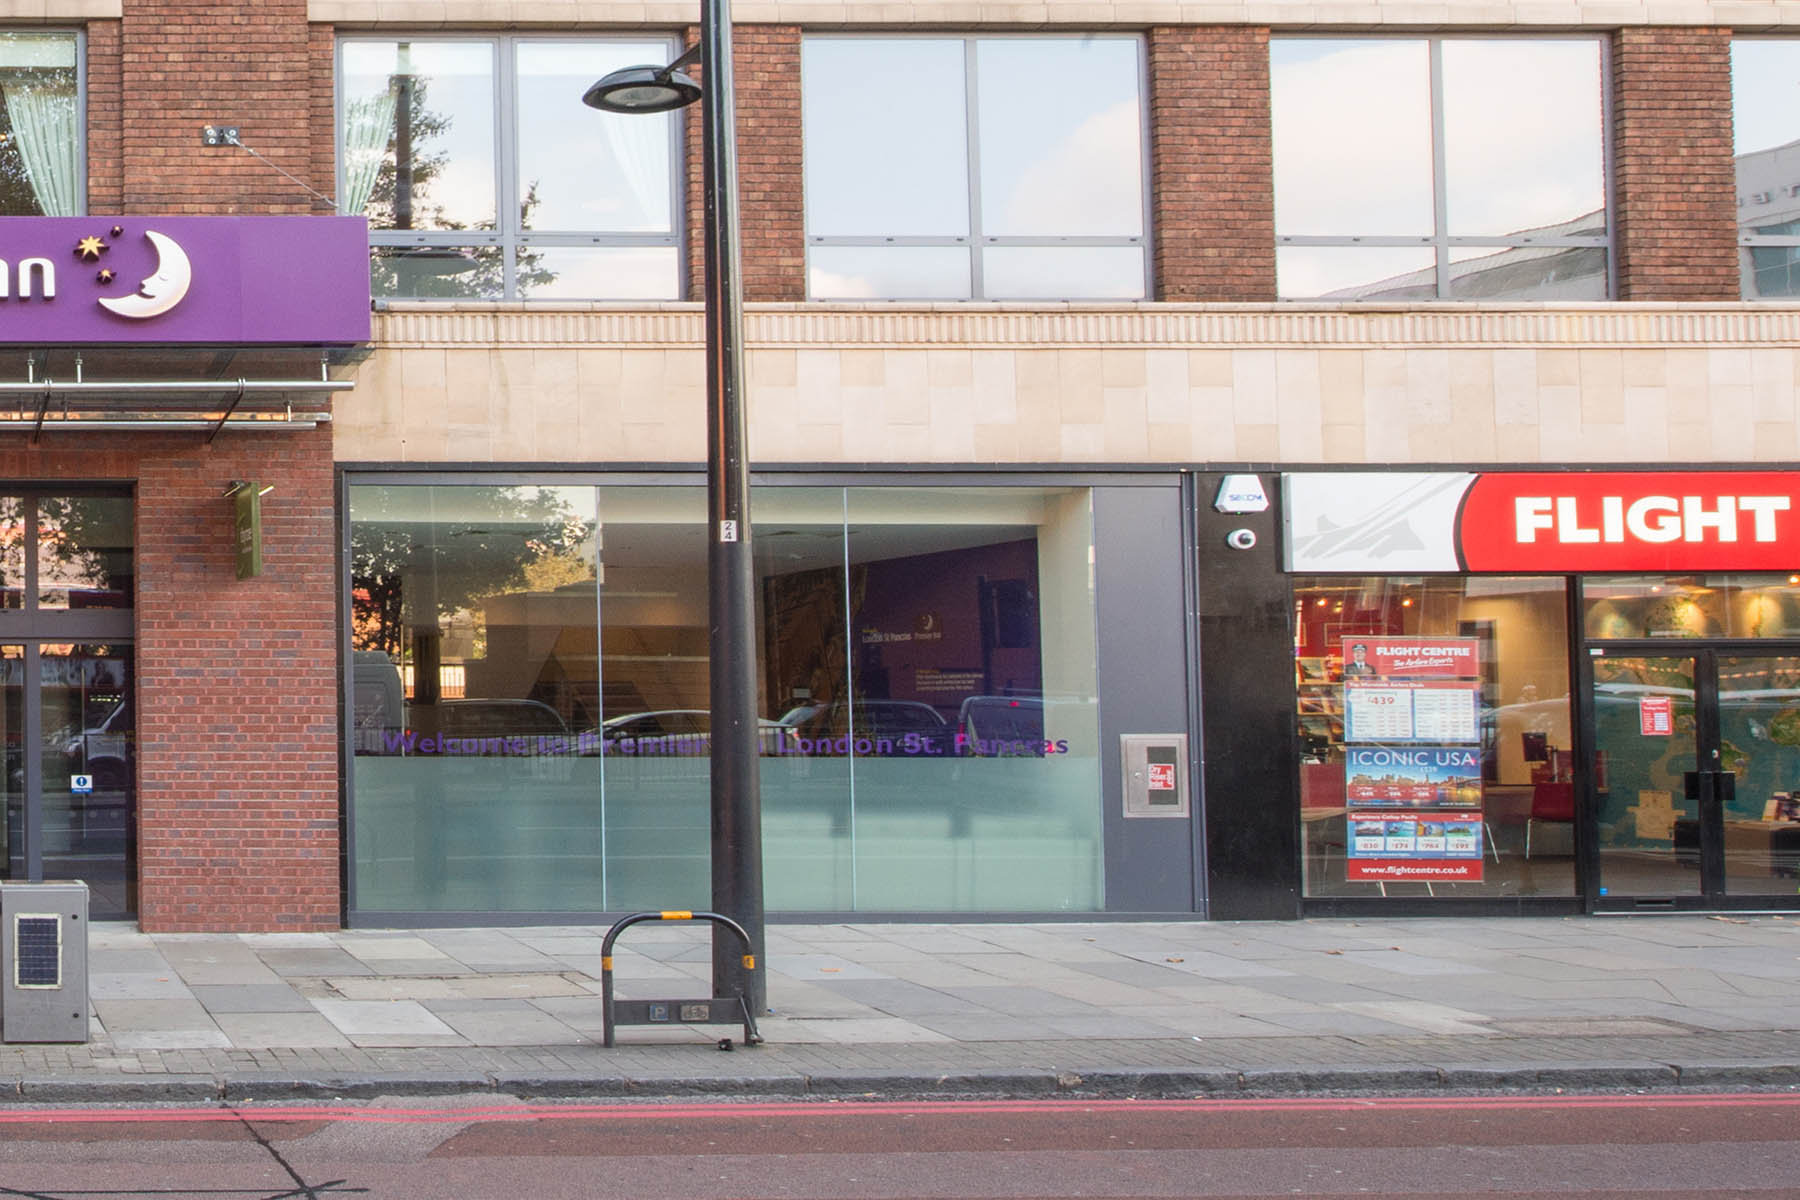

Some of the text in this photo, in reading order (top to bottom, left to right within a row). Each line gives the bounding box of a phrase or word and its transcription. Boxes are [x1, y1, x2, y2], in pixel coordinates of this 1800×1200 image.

[1514, 495, 1791, 543] FLIGHT
[1375, 647, 1470, 656] FLIGHT CENTRE
[382, 731, 527, 753] Welcome
[539, 734, 570, 753] to
[778, 732, 893, 753] London
[903, 732, 942, 753] St.
[954, 733, 1068, 754] Pancras
[1352, 751, 1476, 766] ICONIC USA
[1361, 866, 1468, 875] www.flightcentre.co.uk
